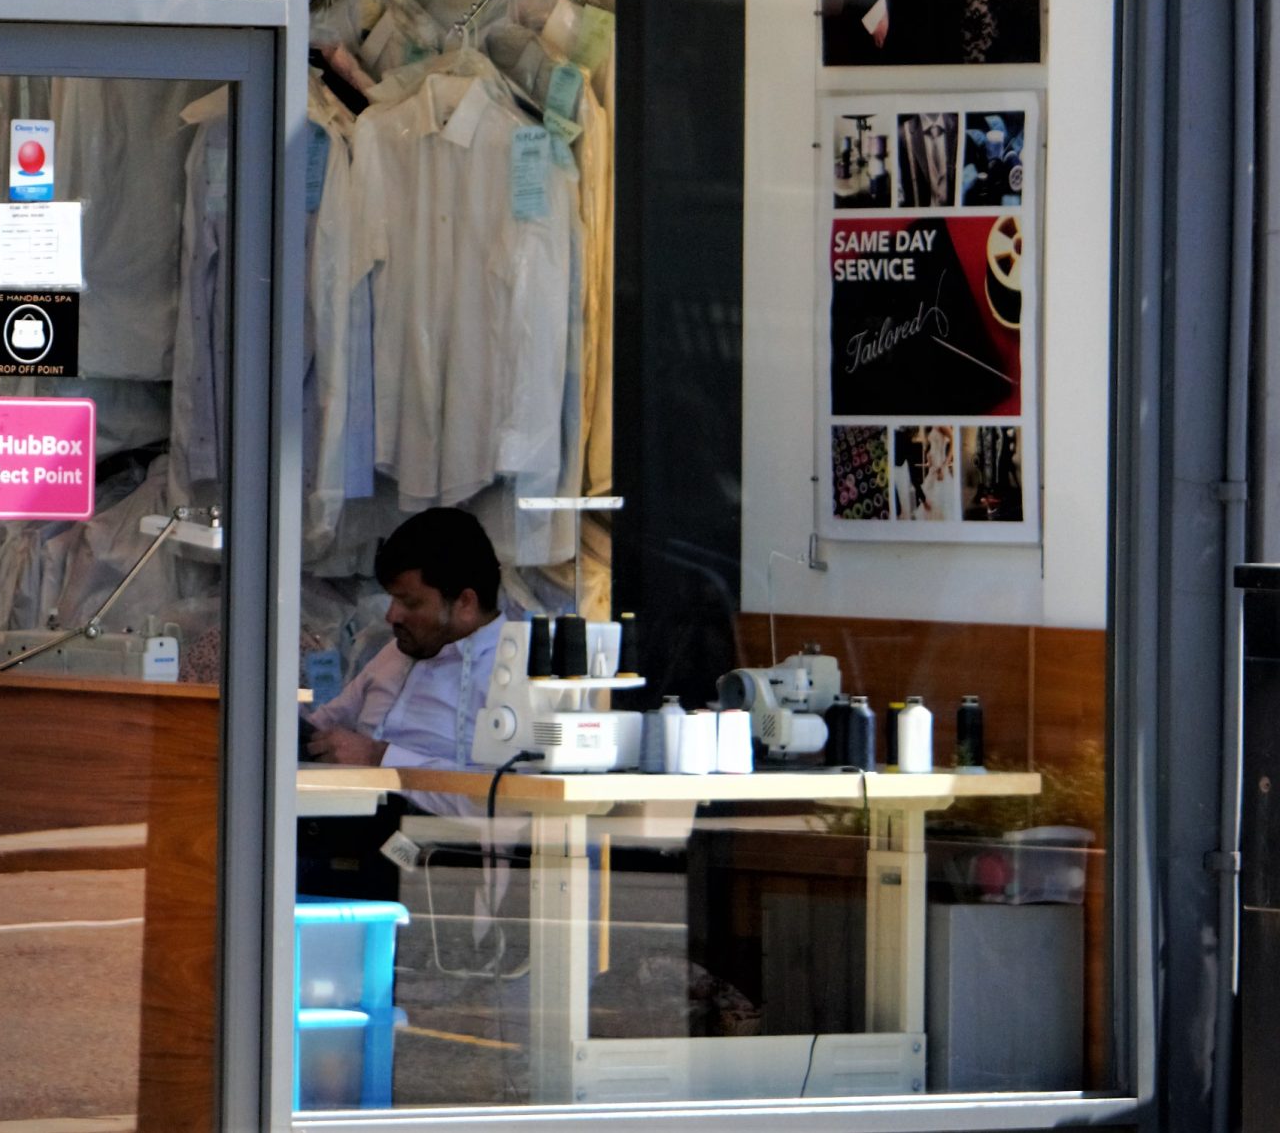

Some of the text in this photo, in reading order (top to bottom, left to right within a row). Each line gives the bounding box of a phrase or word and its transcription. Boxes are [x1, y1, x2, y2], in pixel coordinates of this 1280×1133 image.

[833, 229, 937, 254] SAME DAY
[833, 258, 916, 281] SERVICE
[6, 294, 52, 303] HANDBAG
[55, 295, 72, 303] SPA
[845, 301, 924, 374] Tailored
[19, 365, 35, 374] OFF
[37, 365, 64, 375] POINT
[34, 467, 83, 485] Point
